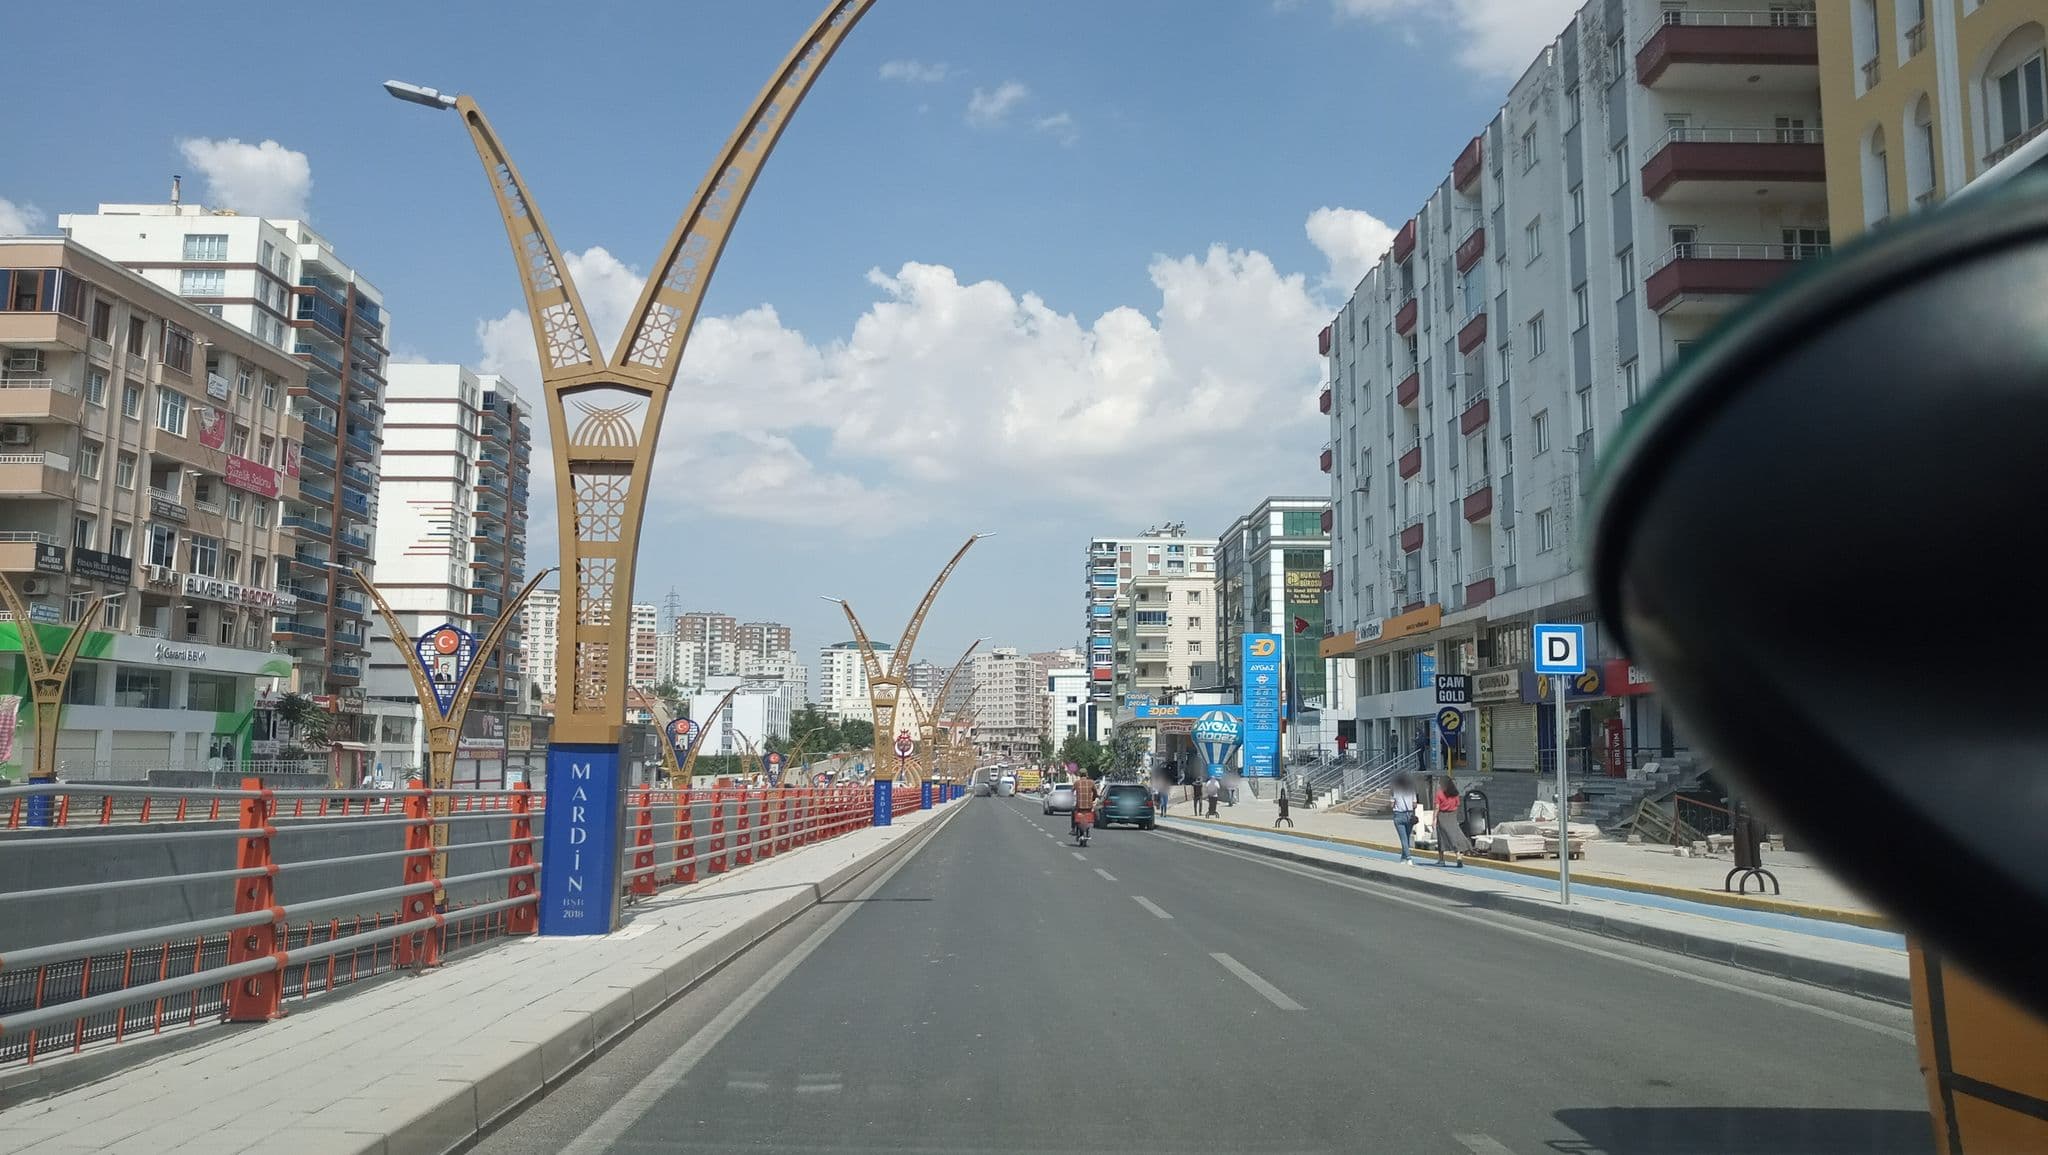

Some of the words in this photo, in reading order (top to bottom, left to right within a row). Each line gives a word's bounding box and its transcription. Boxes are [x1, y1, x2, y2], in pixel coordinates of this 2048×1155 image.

[1548, 637, 1570, 661] D
[1438, 676, 1464, 689] ÇAM
[1440, 690, 1464, 702] GOLD
[1199, 721, 1238, 734] AYGAZ
[563, 909, 584, 918] 2018
